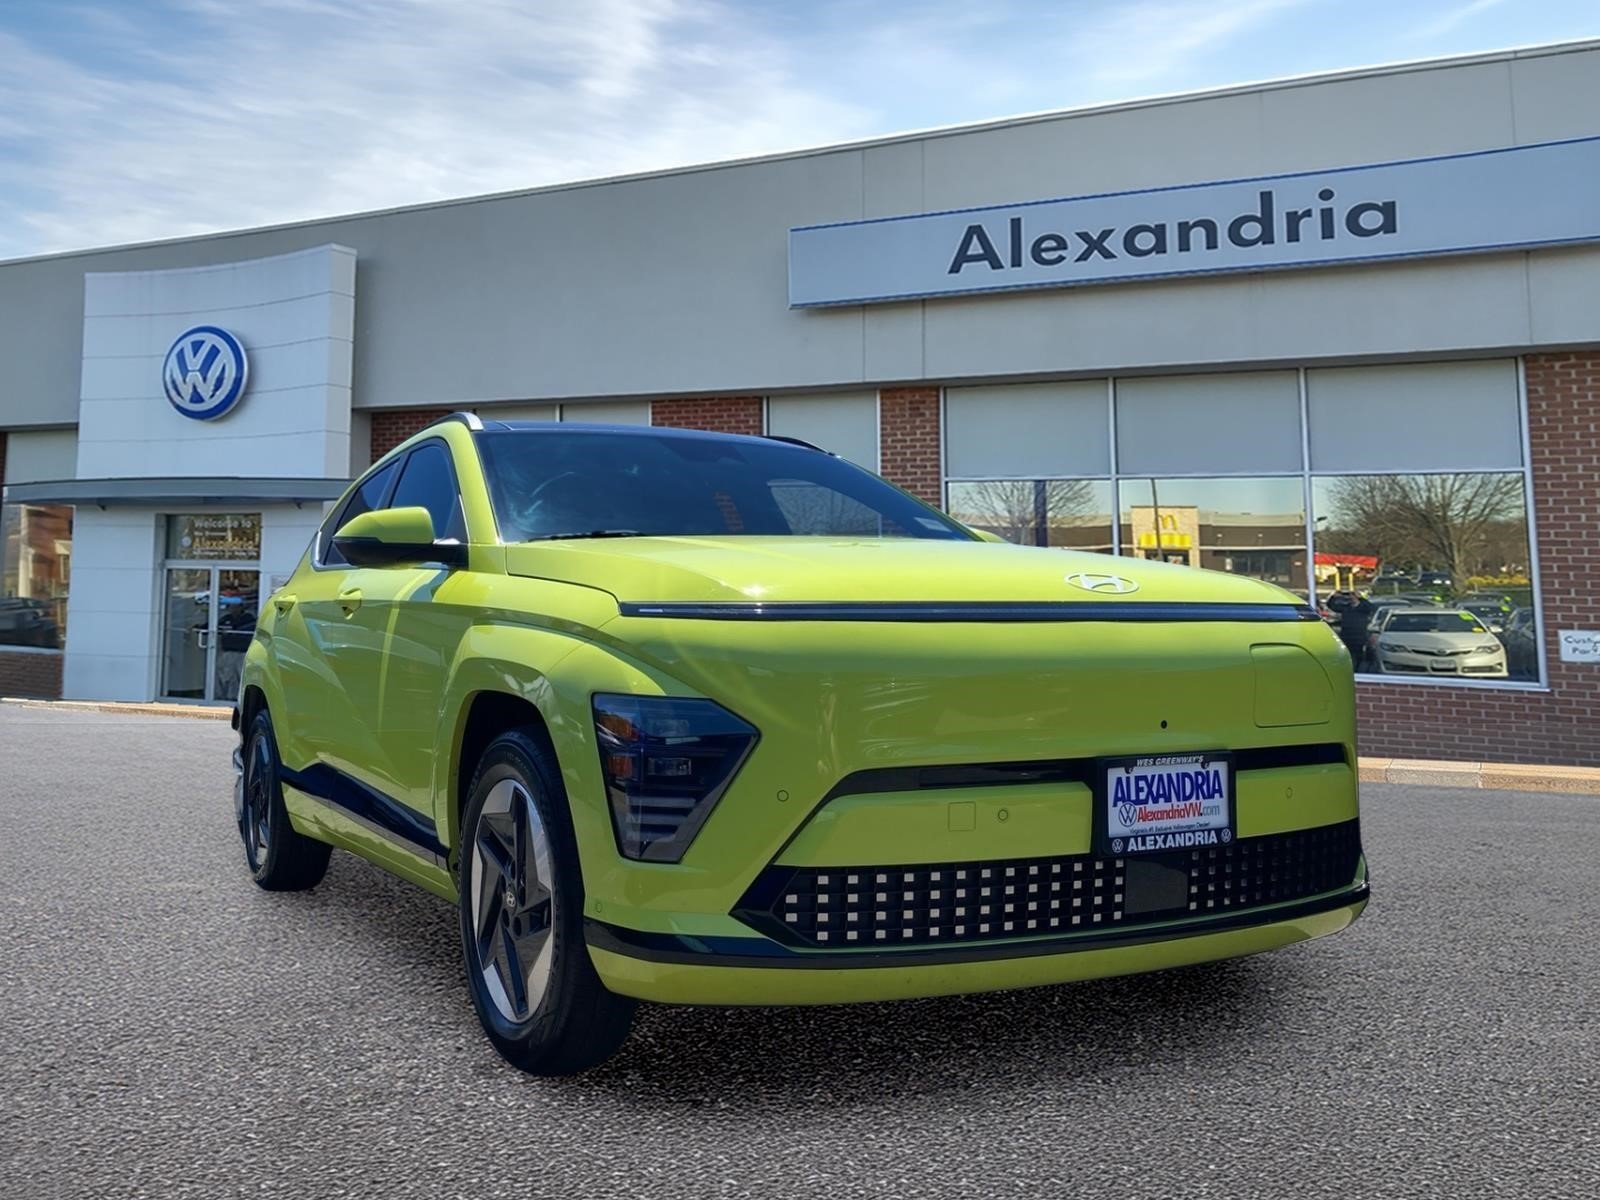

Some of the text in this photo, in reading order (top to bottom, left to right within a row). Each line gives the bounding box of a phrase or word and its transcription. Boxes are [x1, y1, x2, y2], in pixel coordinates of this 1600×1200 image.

[948, 188, 1398, 275] Alexandria
[1112, 769, 1224, 808] ALEXANDRIA
[1137, 801, 1221, 823] AlexandriaVW.com
[1127, 830, 1219, 852] ALEXANDRIA
